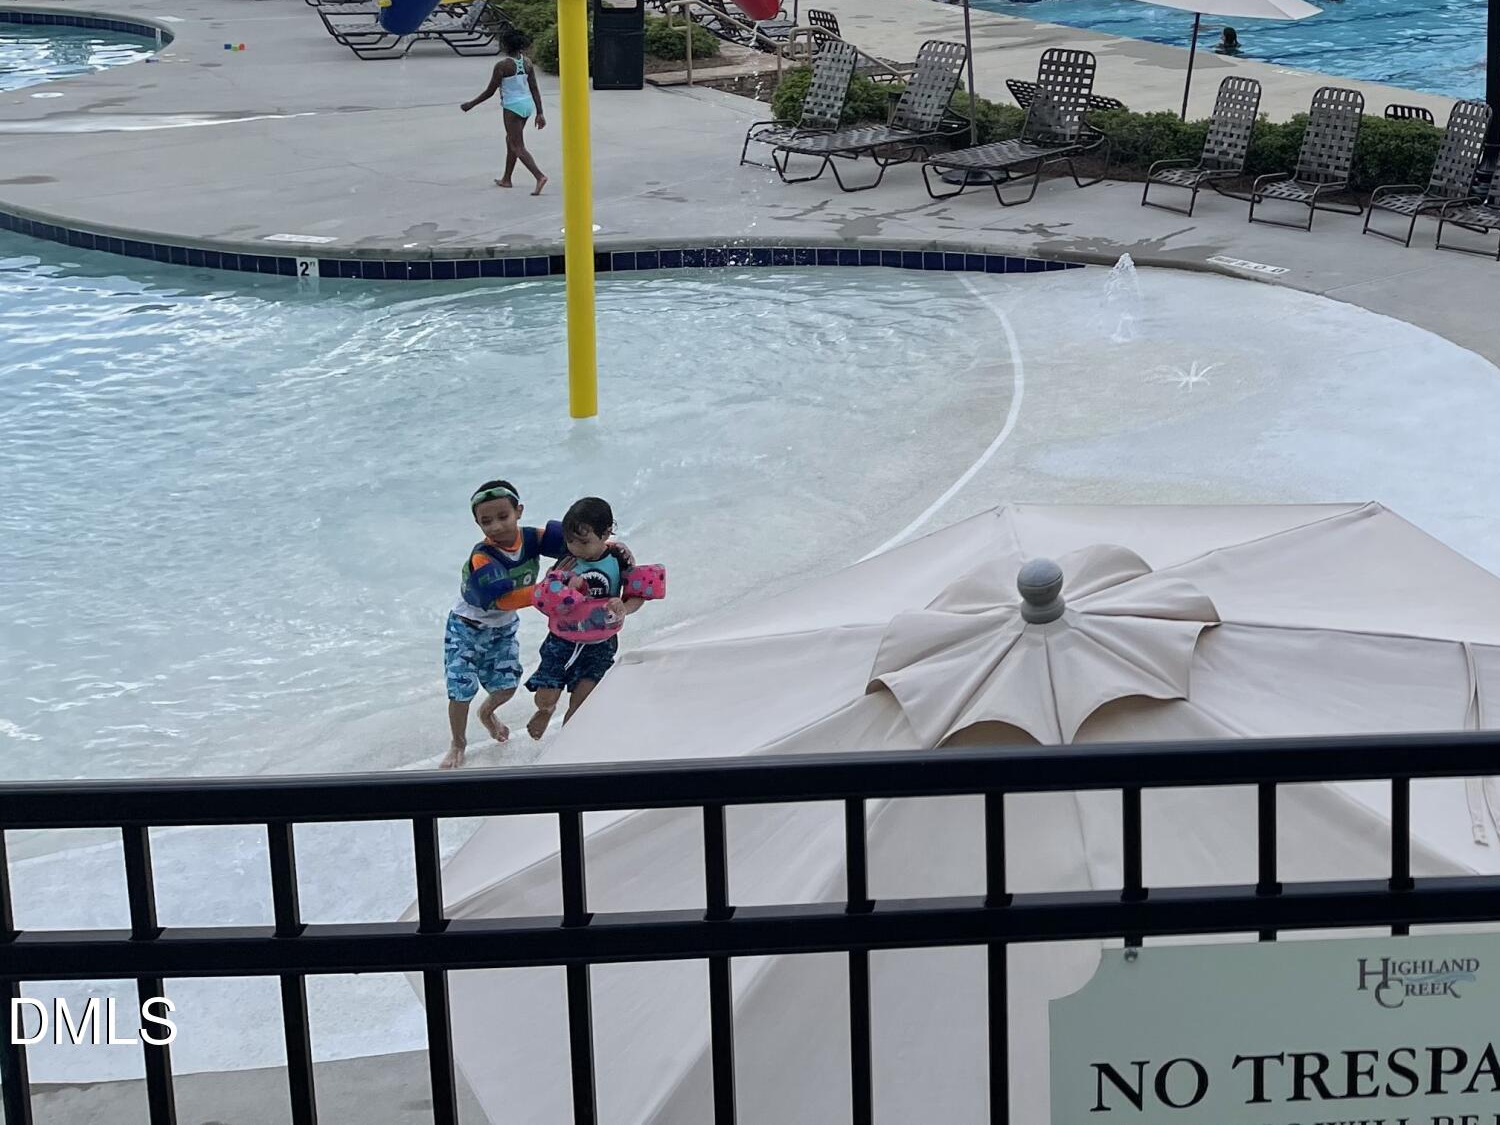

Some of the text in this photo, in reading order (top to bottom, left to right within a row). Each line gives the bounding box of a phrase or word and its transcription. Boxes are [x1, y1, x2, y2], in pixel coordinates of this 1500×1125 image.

[1357, 956, 1480, 991] HIGHLAND
[1374, 976, 1461, 1009] CREEK
[1090, 1057, 1209, 1113] NO
